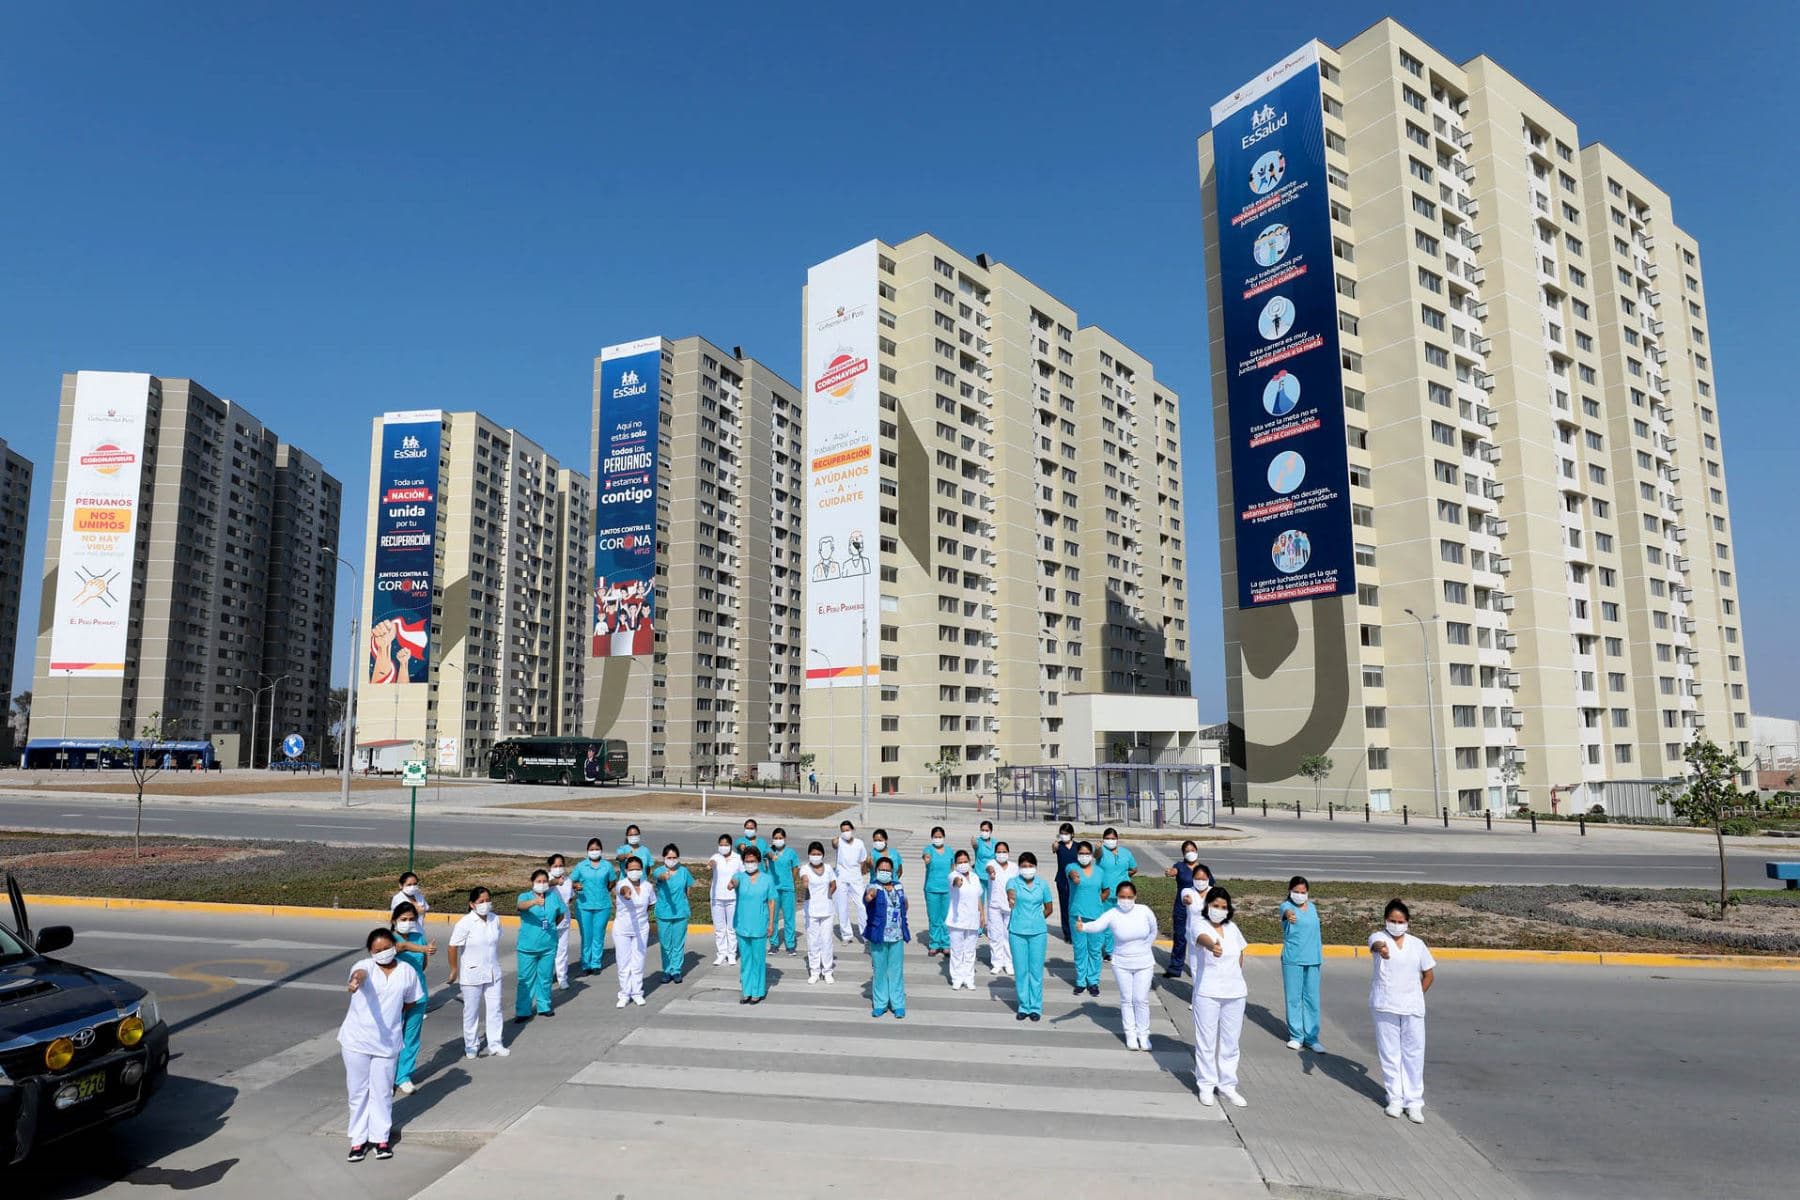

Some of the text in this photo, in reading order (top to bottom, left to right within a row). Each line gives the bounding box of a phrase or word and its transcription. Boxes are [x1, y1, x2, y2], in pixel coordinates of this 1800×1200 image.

[1242, 111, 1288, 149] EsSalud
[1263, 339, 1285, 352] carrera
[1285, 336, 1293, 344] es
[1293, 330, 1308, 341] muy
[1239, 351, 1272, 368] importante
[1272, 345, 1286, 357] para
[1286, 336, 1315, 350] nosotros
[816, 363, 866, 390] CORONAVIRUS
[613, 382, 647, 399] EsSalud
[616, 420, 643, 431] Aquí no
[1250, 424, 1264, 433] Esta
[1264, 421, 1276, 429] vez
[1276, 417, 1283, 425] la
[1282, 413, 1300, 423] meta
[1300, 409, 1310, 417] no
[1253, 429, 1271, 440] ganar
[1301, 415, 1315, 424] sino
[611, 429, 647, 442] estás solo
[393, 448, 428, 459] EsSalud
[611, 444, 645, 457] todos los
[813, 446, 870, 469] RECUPERACIÓN
[603, 452, 652, 475] PERUANOS
[612, 476, 642, 488] estamos
[837, 483, 845, 494] A
[391, 490, 425, 500] NACIÓN
[601, 486, 652, 504] contigo
[818, 490, 864, 508] CUIDARTE
[1293, 499, 1307, 509] para
[1308, 492, 1338, 505] ayudarte
[75, 498, 133, 507] PERUANOS
[90, 511, 115, 521] NOS
[389, 504, 426, 518] unida
[1256, 513, 1279, 523] superar
[79, 520, 126, 530] UNIMOS
[396, 521, 408, 529] por
[600, 523, 652, 537] JUNTOS CONTRA EL
[99, 535, 120, 543] HAY
[380, 532, 432, 547] RECUPERACIÓN
[87, 543, 114, 551] VIRUS
[1258, 578, 1277, 588] gente
[1276, 573, 1308, 584] luchadora
[1324, 569, 1338, 579] que
[1285, 580, 1309, 589] sentido
